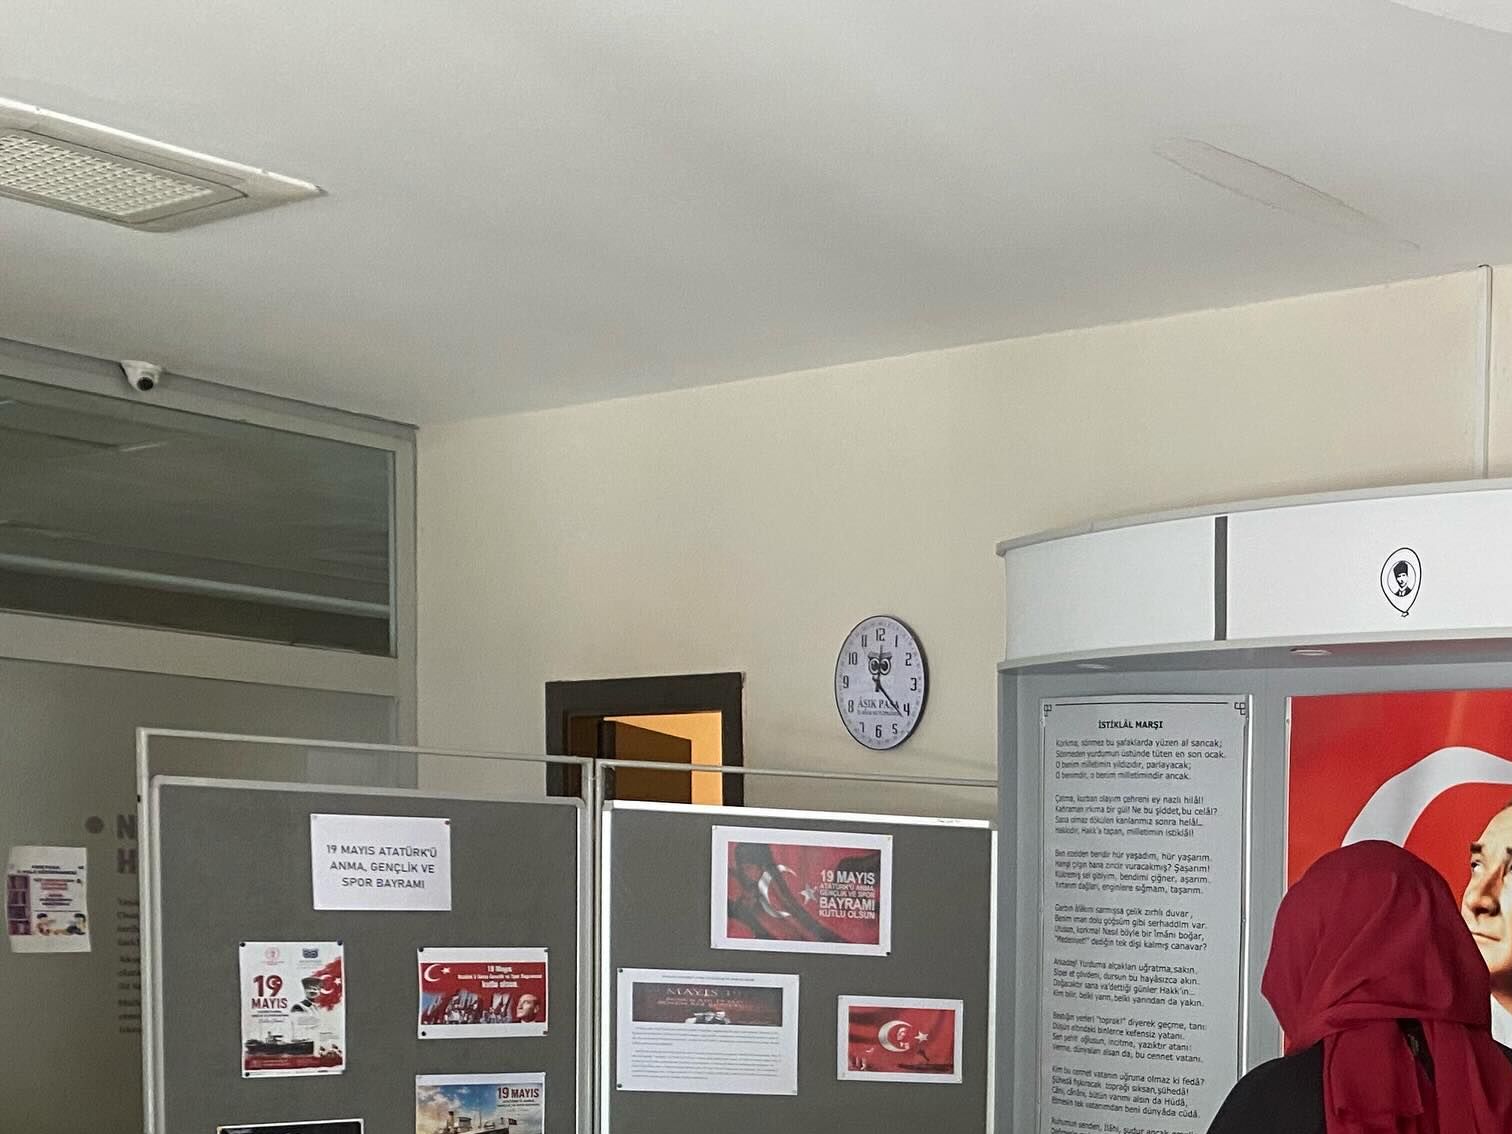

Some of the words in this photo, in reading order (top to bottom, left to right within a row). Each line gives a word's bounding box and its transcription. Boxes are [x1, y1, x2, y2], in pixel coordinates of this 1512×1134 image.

[861, 635, 867, 647] 11
[876, 628, 885, 641] 12
[849, 652, 857, 665] 10
[905, 652, 912, 666] 2
[843, 675, 849, 688] 9
[910, 678, 917, 691] 3
[848, 700, 854, 713] 8
[904, 703, 910, 716] 4
[860, 722, 865, 733] 7
[875, 724, 882, 738] 6
[892, 723, 898, 734] 5
[1135, 721, 1163, 730] MARŞI
[327, 845, 337, 854] 19
[341, 845, 375, 855] MAYIS
[378, 846, 437, 858] ATATÜRK'Ü
[330, 861, 368, 872] ANMA,
[370, 862, 418, 874] GENÇLİK
[421, 864, 435, 873] VE
[342, 877, 372, 887] SPOR
[376, 879, 425, 889] BAYRAMI
[821, 869, 834, 882] 19
[837, 870, 875, 885] MAYIS
[820, 897, 875, 911] BAYRAMI
[847, 911, 875, 919] OLSUN
[253, 975, 283, 997] 19
[251, 998, 288, 1009] MAYIS
[497, 1087, 509, 1099] 19
[511, 1088, 539, 1099] MAYIS
